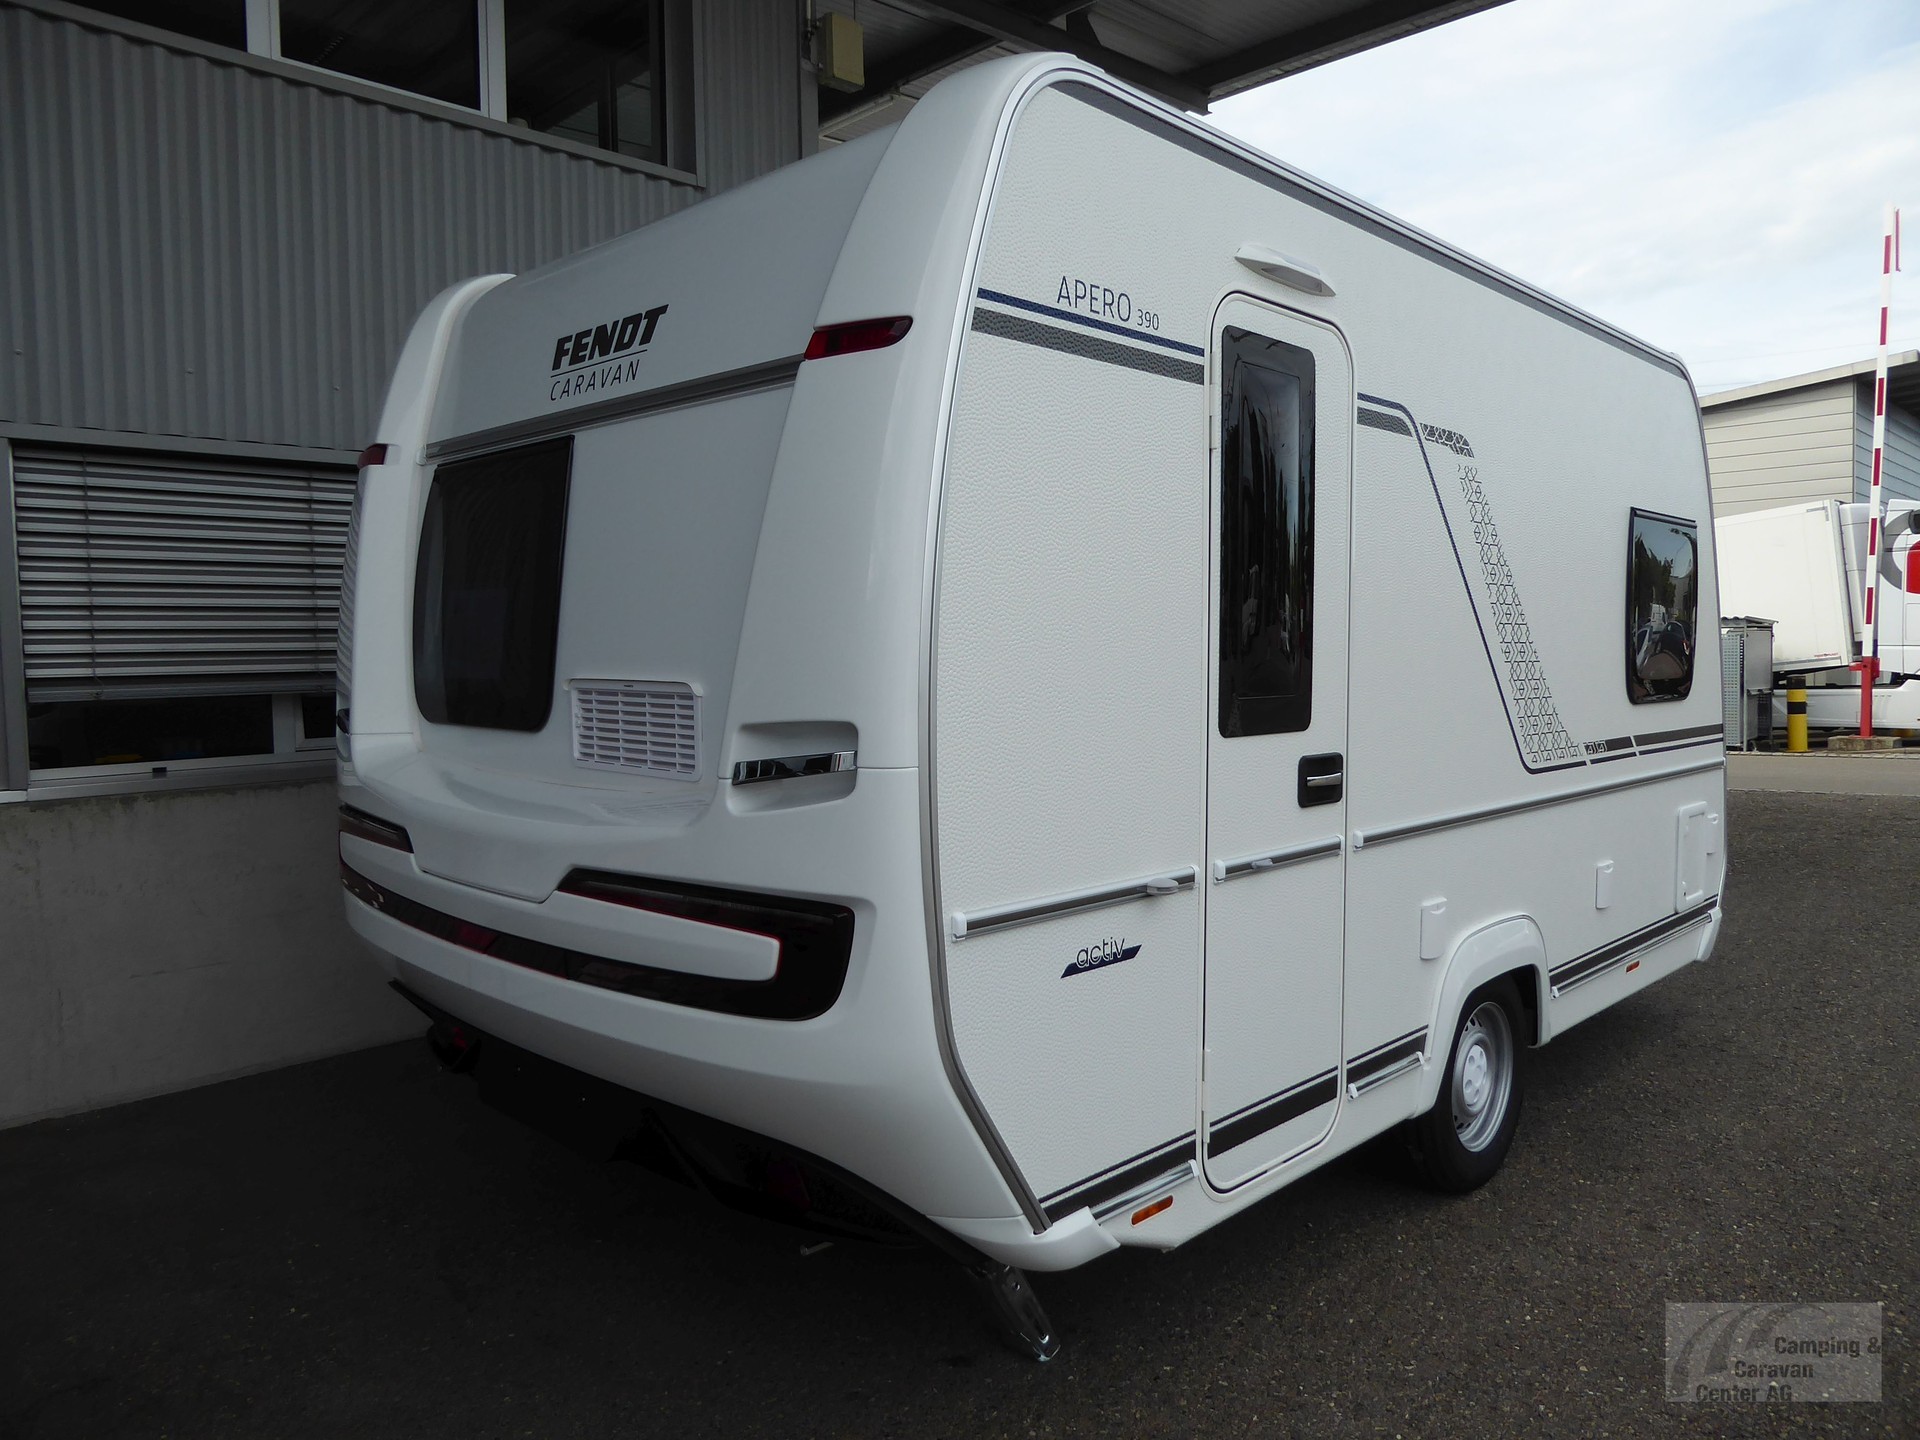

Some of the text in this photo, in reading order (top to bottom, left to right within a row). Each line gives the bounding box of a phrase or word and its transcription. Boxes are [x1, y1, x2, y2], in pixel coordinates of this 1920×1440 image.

[1057, 275, 1159, 330] APERO 390
[552, 304, 669, 371] FENDT
[551, 359, 640, 401] CARAVAN
[1076, 936, 1125, 968] activ
